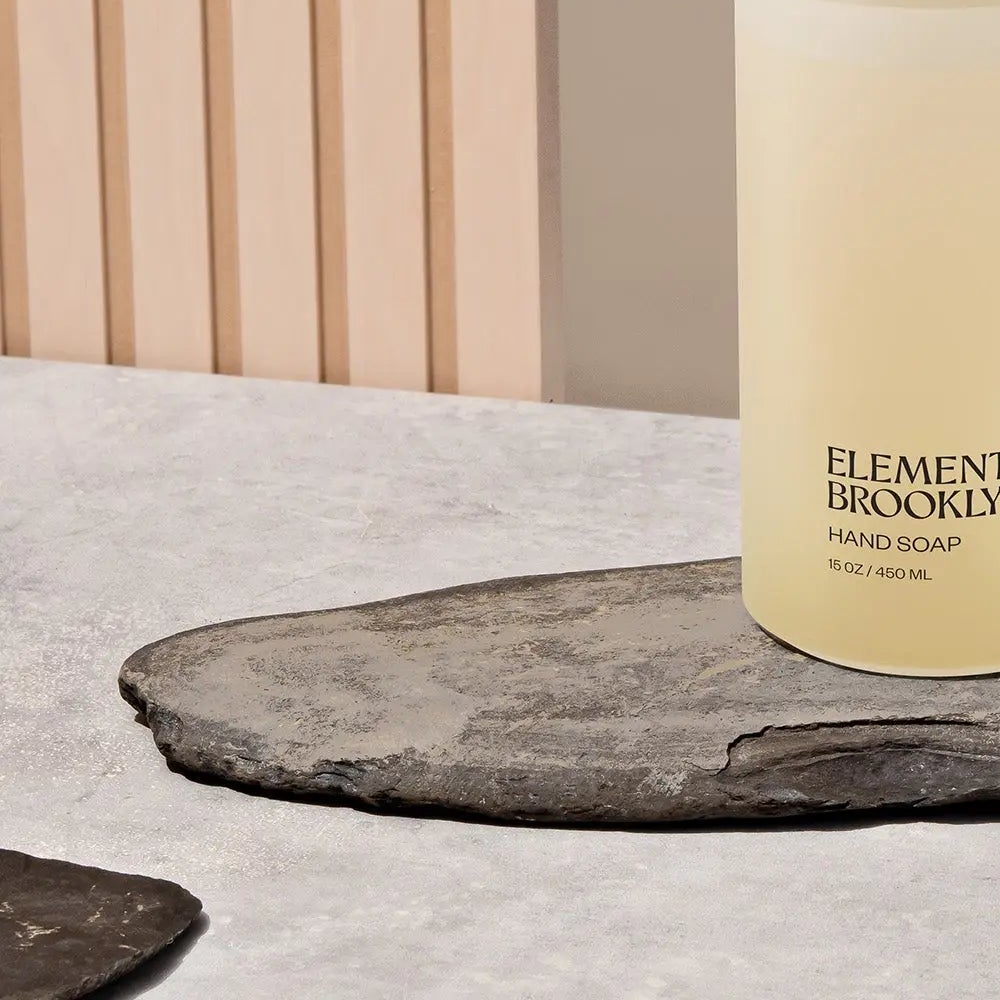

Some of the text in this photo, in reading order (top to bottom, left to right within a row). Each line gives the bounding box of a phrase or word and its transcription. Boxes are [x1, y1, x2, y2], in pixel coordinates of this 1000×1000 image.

[829, 526, 962, 553] HAND SOAP
[828, 558, 842, 572] 15
[844, 561, 864, 576] OZ
[875, 566, 906, 580] 450
[909, 568, 933, 581] ML
